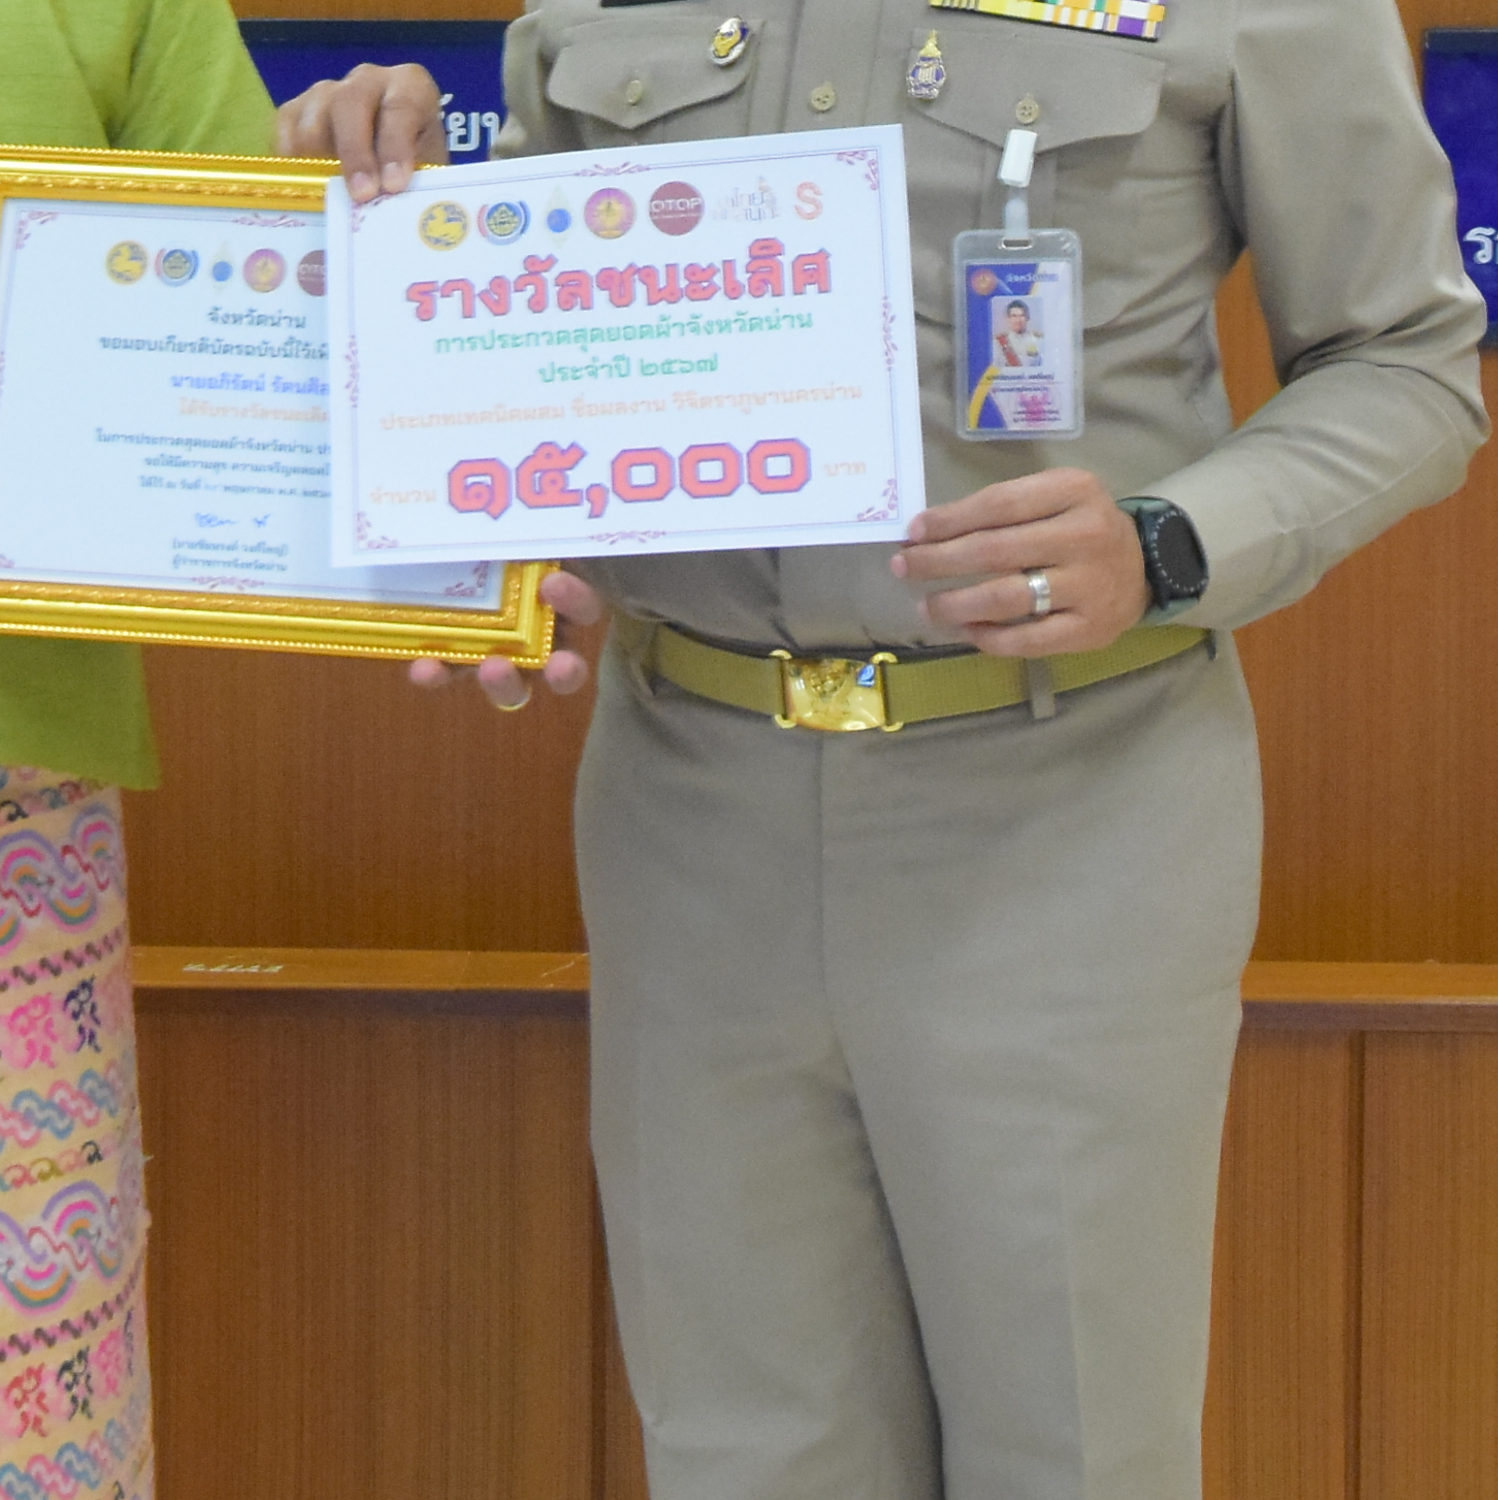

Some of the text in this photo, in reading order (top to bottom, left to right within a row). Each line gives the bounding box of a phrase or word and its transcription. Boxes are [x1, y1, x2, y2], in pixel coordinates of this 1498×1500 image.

[651, 196, 703, 214] OTOP
[404, 237, 833, 323] รางวัลชนะเลิศ
[207, 305, 307, 329] จังหวัดน่าน
[434, 307, 814, 354] การประกวดสุดยอดผ้าจังหวัดน่าน
[538, 352, 719, 384] ประจำปี ๒๕๖๗
[571, 391, 666, 418] ชื่อผลงาน
[369, 437, 867, 521] จำนวน ๑๕,๐๐๐ บาท
